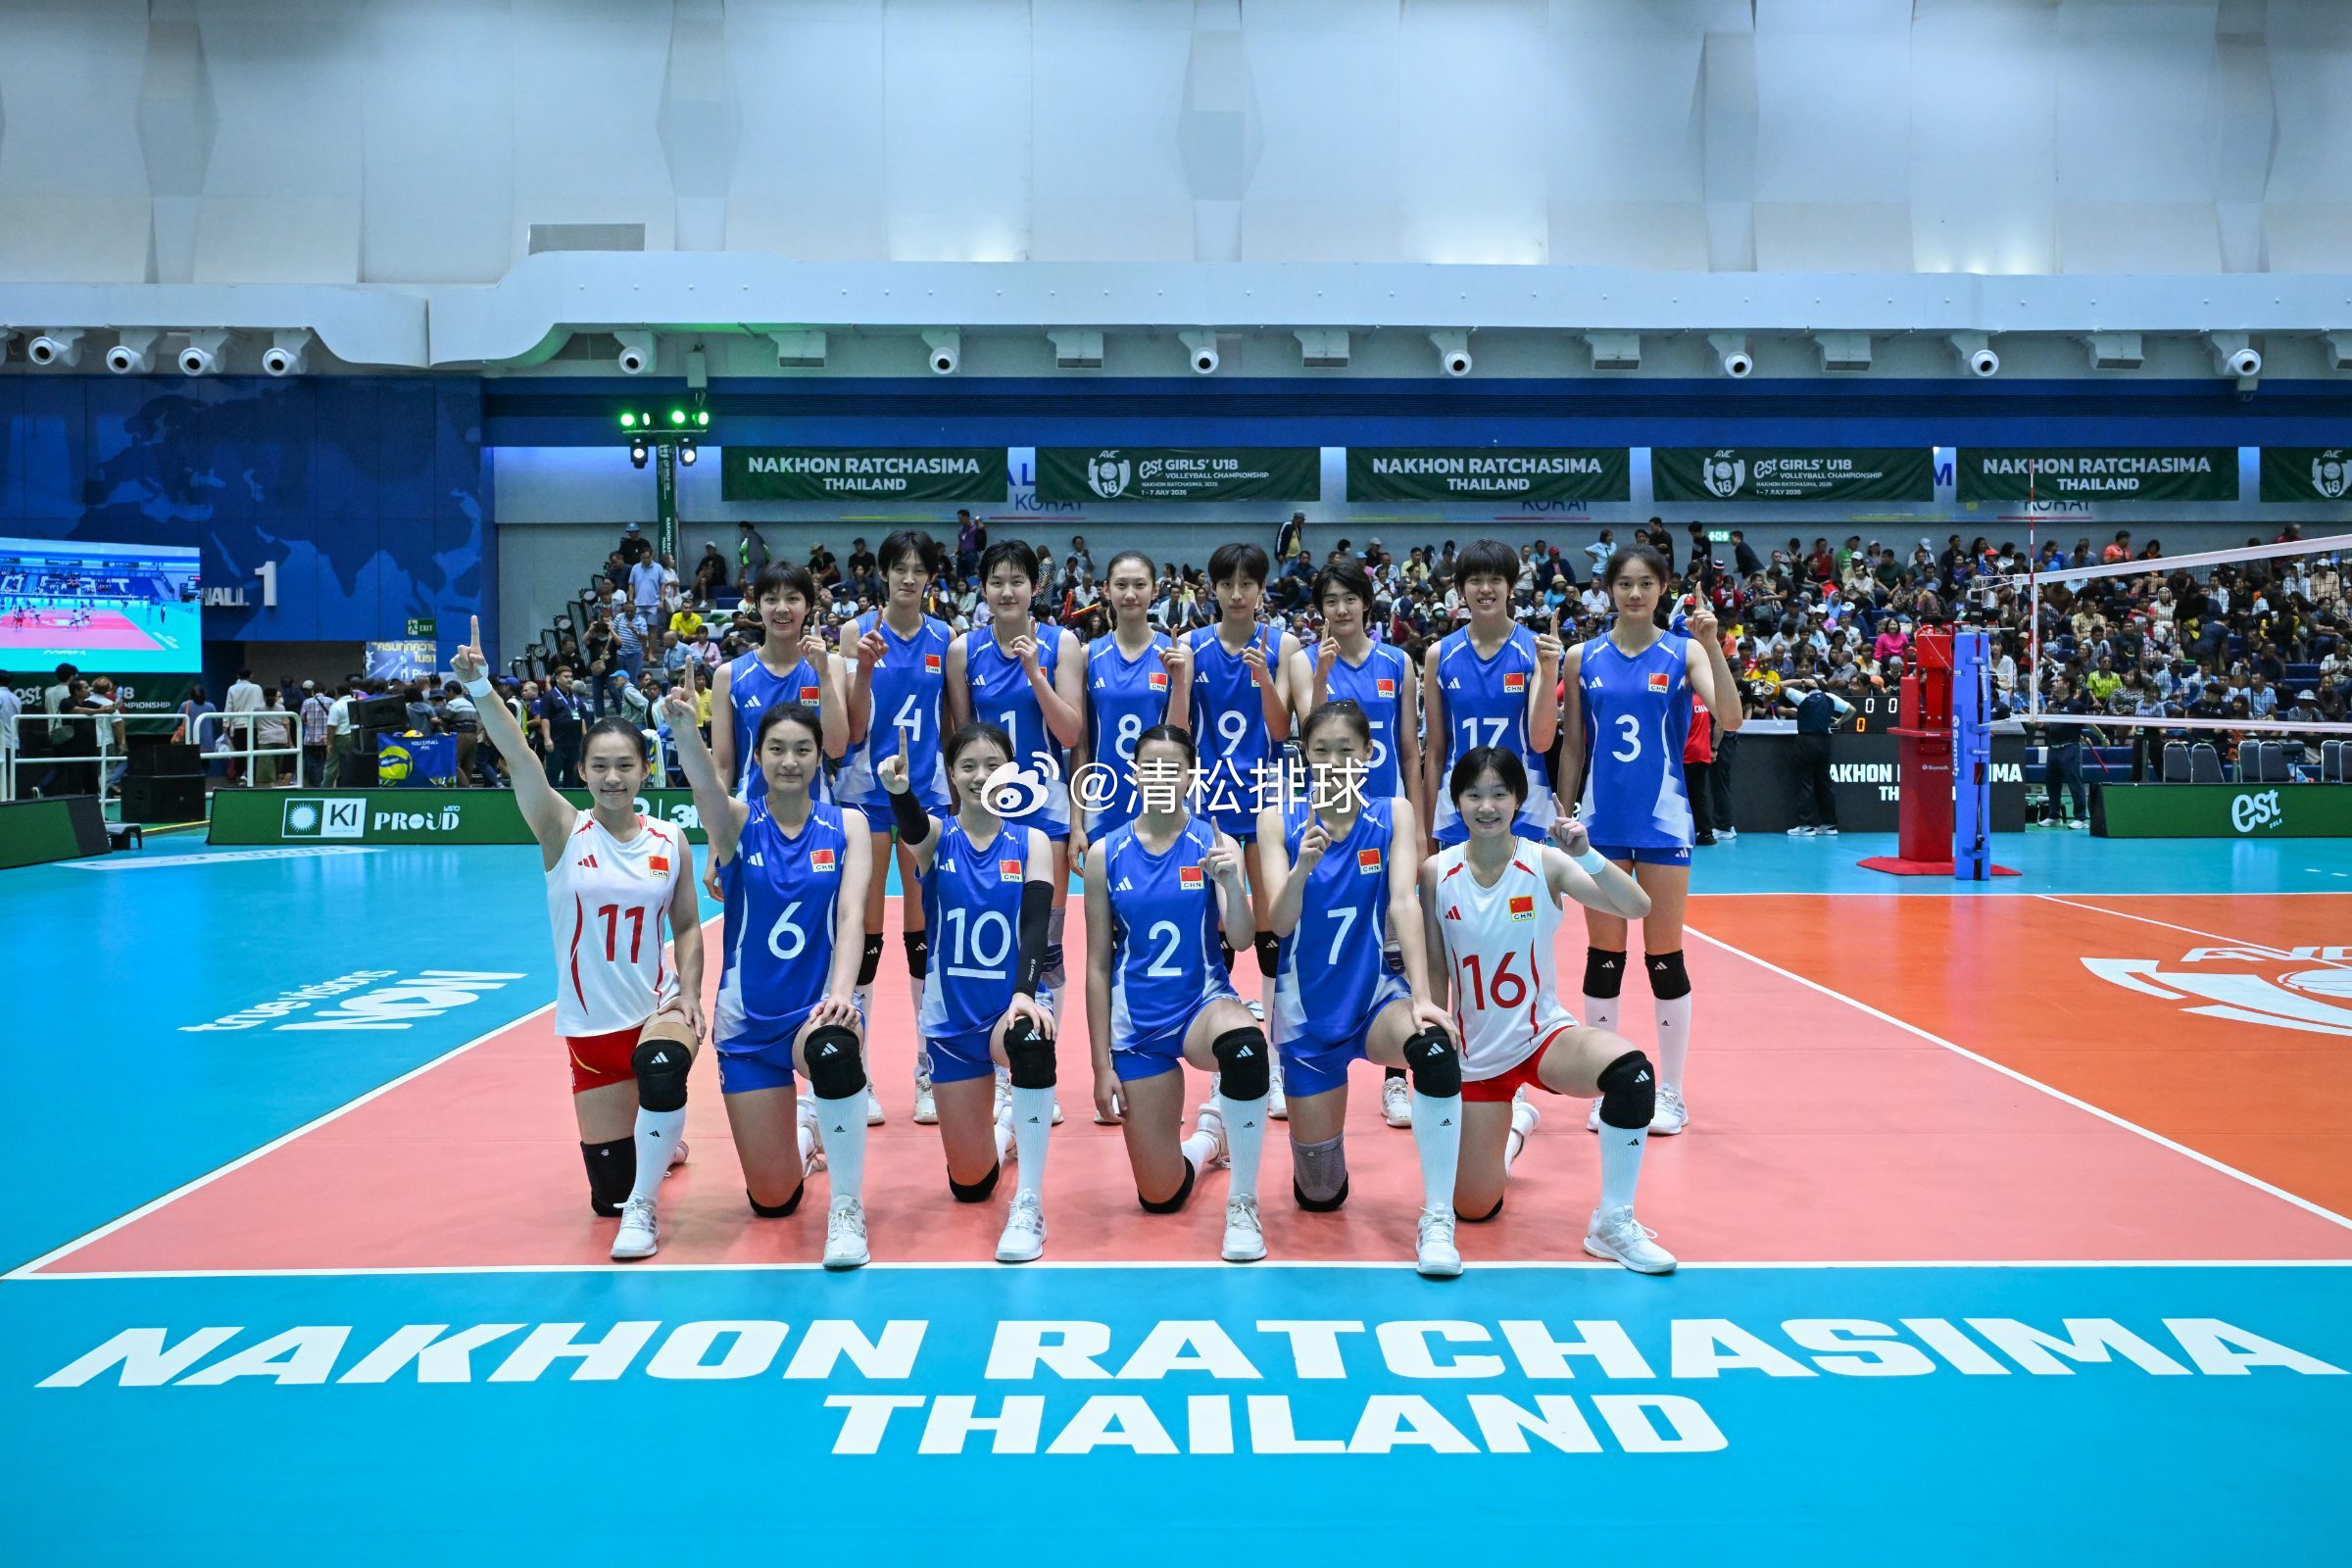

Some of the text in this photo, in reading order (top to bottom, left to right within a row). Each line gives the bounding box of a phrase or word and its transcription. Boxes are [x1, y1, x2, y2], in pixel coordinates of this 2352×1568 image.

[748, 457, 981, 474] NAKHON RATCHASIMA
[1139, 458, 1239, 478] est GIRLS' U18
[1372, 458, 1603, 473] NAKHON RATCHASIMA
[1753, 458, 1852, 479] est GIRLS' U18
[1983, 457, 2212, 474] NAKHON RATCHASIMA
[823, 478, 907, 490] THAILAND
[1102, 480, 1118, 494] 18
[1446, 478, 1531, 491] THAILAND
[1716, 480, 1733, 494] 18
[2056, 478, 2139, 491] THAILAND
[2325, 480, 2340, 494] 18
[255, 562, 277, 607] 1
[1649, 685, 1667, 694] CHN
[1865, 698, 1898, 713] 0 0
[893, 694, 922, 742] 4
[1856, 717, 1866, 733] 0
[1000, 710, 1016, 757] 1
[1115, 713, 1143, 760] 8
[1217, 710, 1248, 756] 9
[1461, 717, 1509, 750] 17
[1612, 714, 1642, 762] 3
[1830, 763, 1893, 783] AKHON
[329, 804, 358, 827] KI
[374, 812, 460, 831] PROUD
[2231, 788, 2281, 833] est
[1004, 873, 1022, 882] CHN
[1361, 864, 1381, 873] CHN
[1513, 910, 1534, 920] CHN
[597, 904, 646, 964] 11
[767, 902, 806, 959] 6
[947, 907, 1011, 967] 10
[1327, 906, 1357, 965] 7
[1148, 920, 1182, 977] 2
[1462, 952, 1526, 1011] 16
[175, 969, 399, 1032] truevisions
[271, 970, 529, 1031] NOW
[34, 1318, 2348, 1389] NAKHON RATCHASIMA
[823, 1395, 1729, 1454] THAILAND
